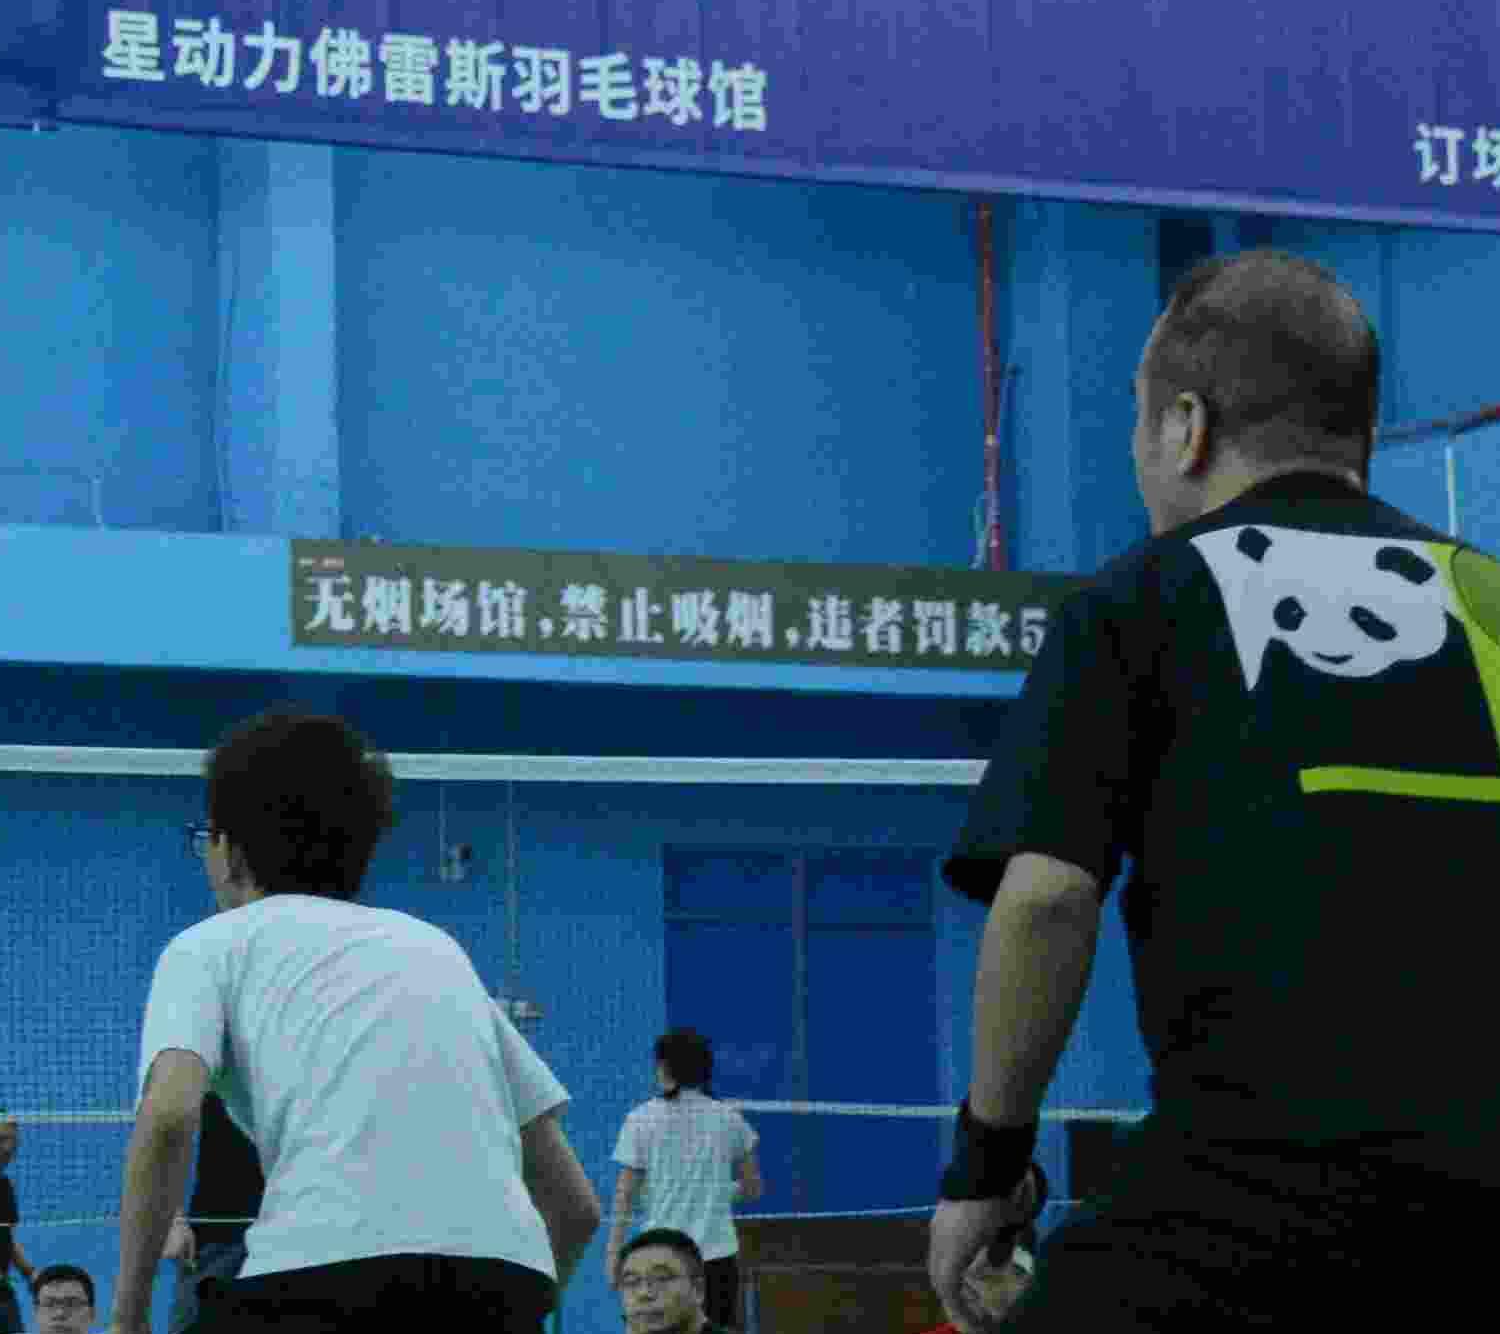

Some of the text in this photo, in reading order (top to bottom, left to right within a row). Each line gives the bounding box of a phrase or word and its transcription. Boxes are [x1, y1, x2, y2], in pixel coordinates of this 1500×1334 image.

[102, 9, 768, 131] 星动力佛雷斯羽毛球馆
